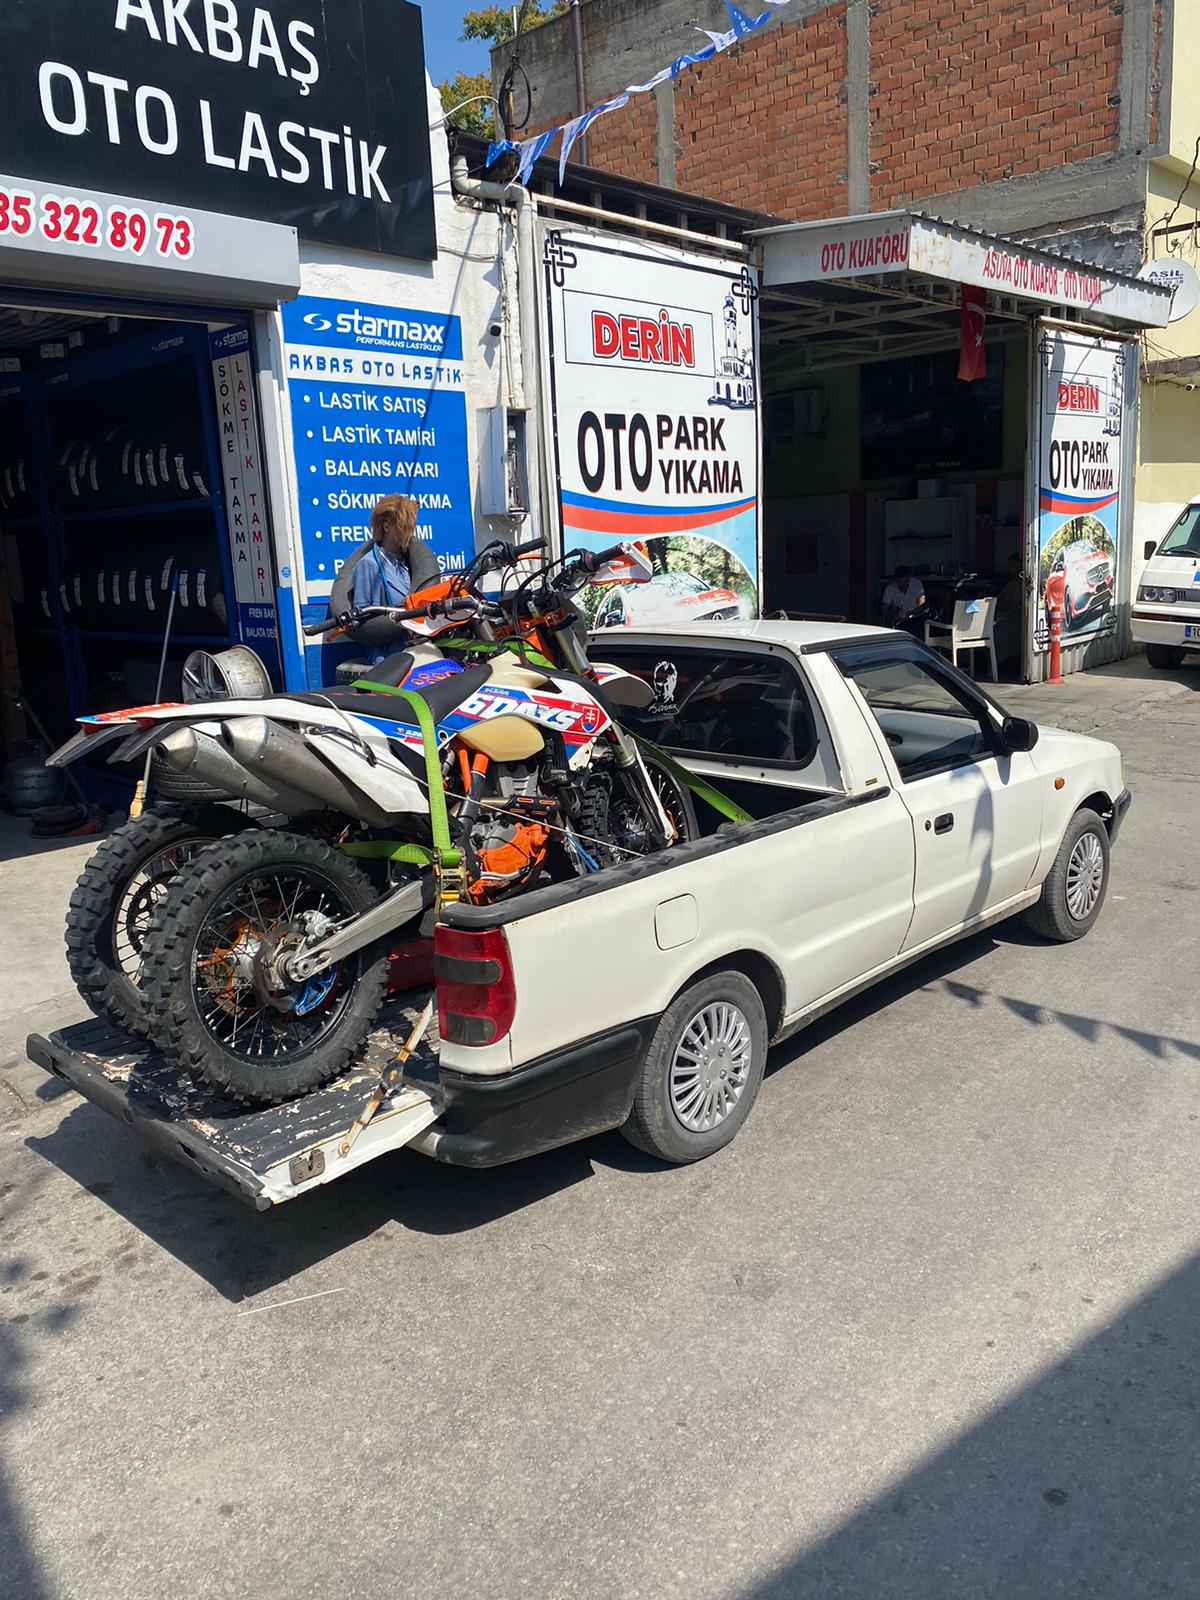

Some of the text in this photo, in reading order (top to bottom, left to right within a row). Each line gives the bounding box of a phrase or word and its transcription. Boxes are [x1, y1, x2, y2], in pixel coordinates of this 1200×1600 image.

[39, 61, 391, 203] OTO LASTİK
[44, 201, 98, 244] 322
[110, 211, 146, 252] 89
[157, 218, 190, 255] 73
[821, 226, 909, 272] OTO KUAFÖRÜ
[1013, 257, 1029, 289] OTO
[1064, 271, 1077, 300] OTO
[1079, 274, 1102, 304] YIKAMA
[336, 308, 445, 344] starmaxx
[356, 336, 405, 349] PERFORMANS
[592, 309, 695, 368] DERİN
[362, 360, 395, 377] OTO
[319, 390, 427, 417] LASTİK SATIŞ
[1058, 378, 1099, 413] DERİN
[322, 424, 436, 446] LASTİK TAMİRİ
[577, 411, 726, 494] OTO PARK
[218, 365, 247, 561] SÖKME TAKMA
[325, 459, 439, 478] BALANS AYARI
[658, 459, 743, 495] YIKAMA
[1049, 440, 1109, 489] OTO PARK
[1082, 469, 1113, 490] YIKAMA
[459, 695, 584, 731] 6DAYS
